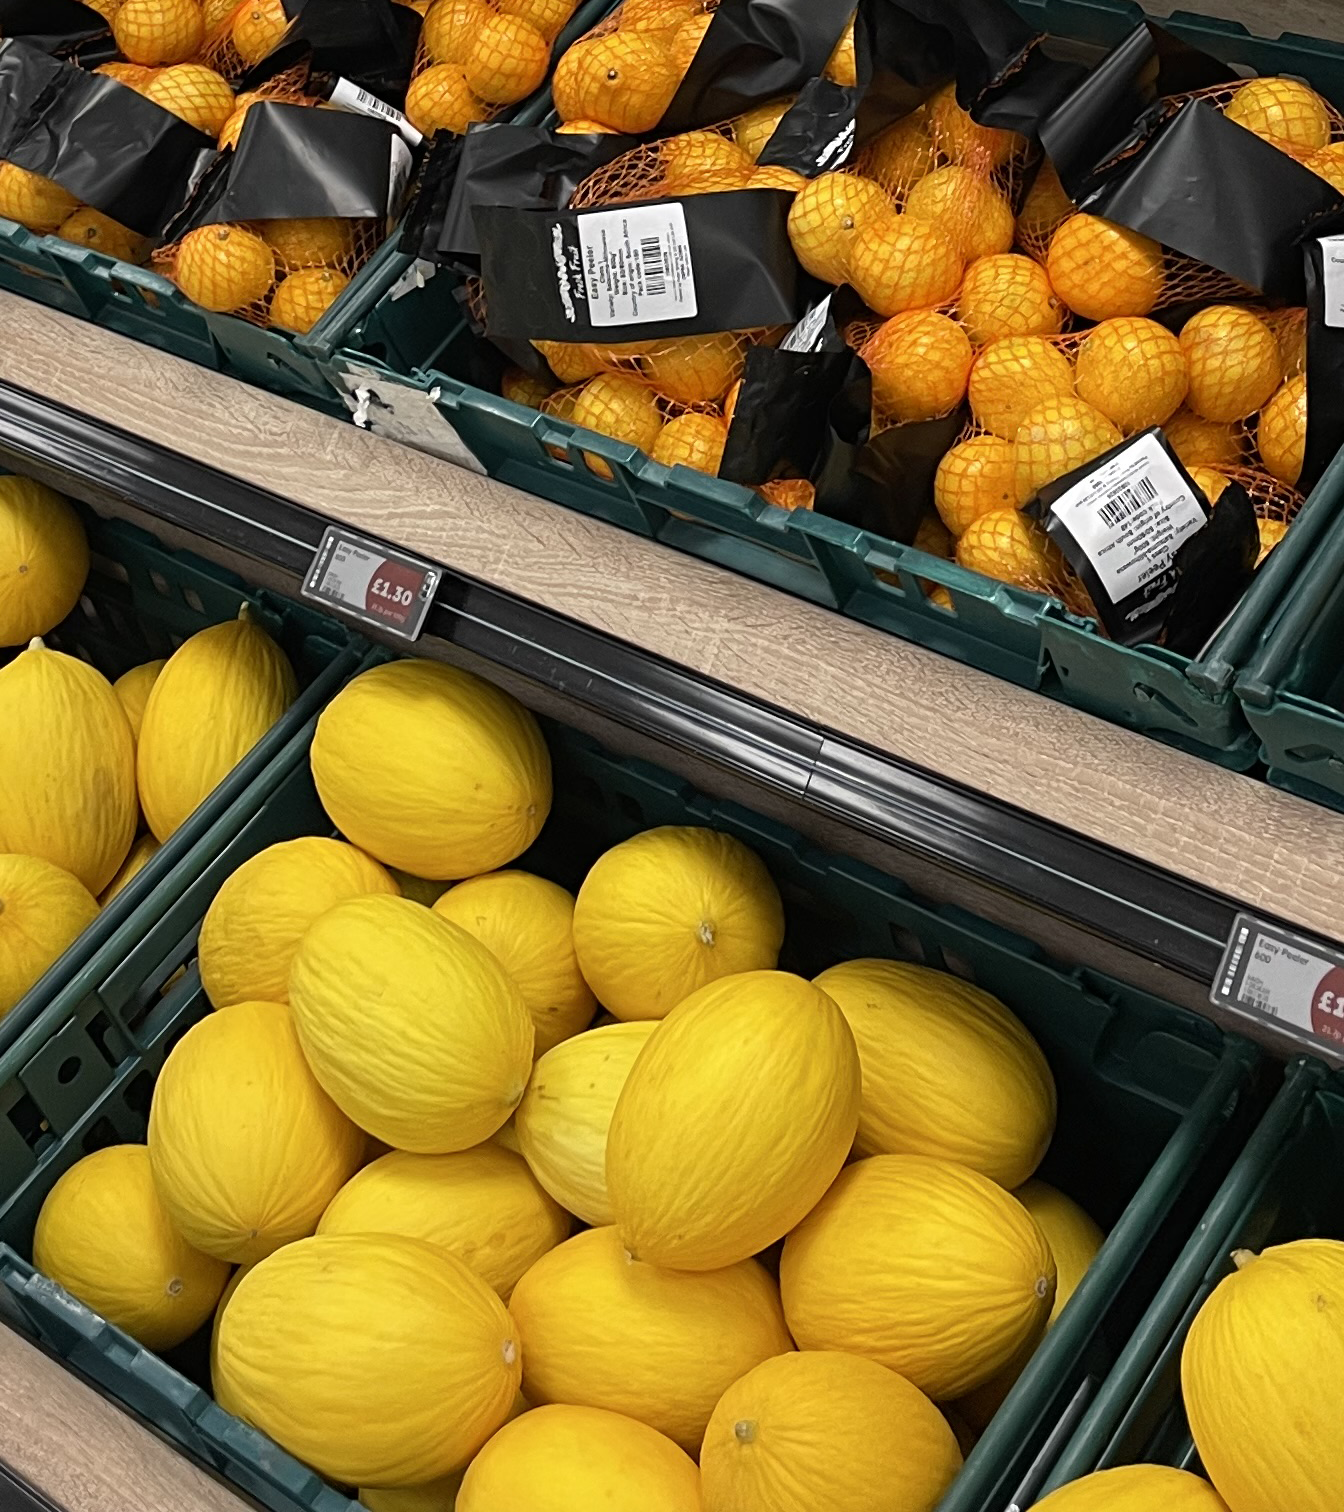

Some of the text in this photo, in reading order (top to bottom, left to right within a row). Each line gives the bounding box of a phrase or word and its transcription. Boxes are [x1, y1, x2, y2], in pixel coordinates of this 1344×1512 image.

[585, 245, 600, 300] Easy Peeler
[370, 577, 413, 606] £1.30
[1253, 950, 1272, 964] 600
[1258, 937, 1310, 966] Easy Peeler
